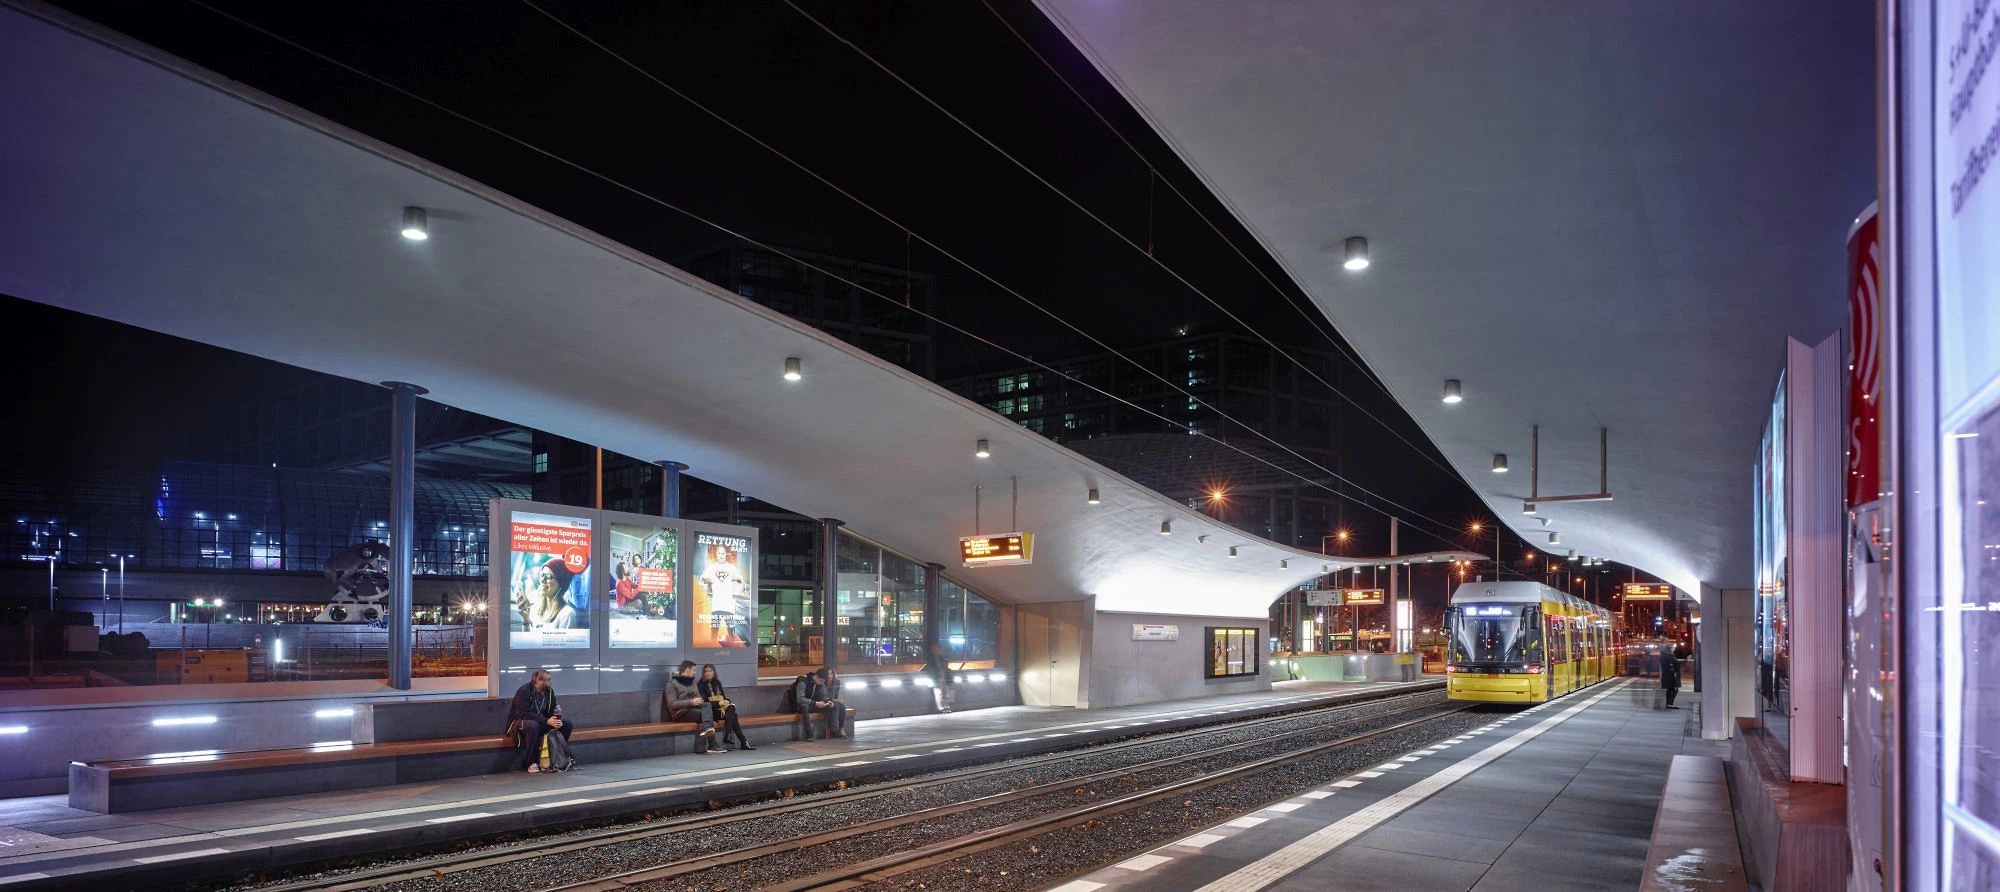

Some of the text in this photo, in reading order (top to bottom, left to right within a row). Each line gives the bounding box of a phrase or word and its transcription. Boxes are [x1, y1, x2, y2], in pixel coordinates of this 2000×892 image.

[526, 527, 558, 535] günstigste
[559, 529, 586, 538] Sparpreis
[529, 535, 549, 543] Zeiten
[698, 534, 746, 547] RETTUNG
[569, 554, 583, 566] 19
